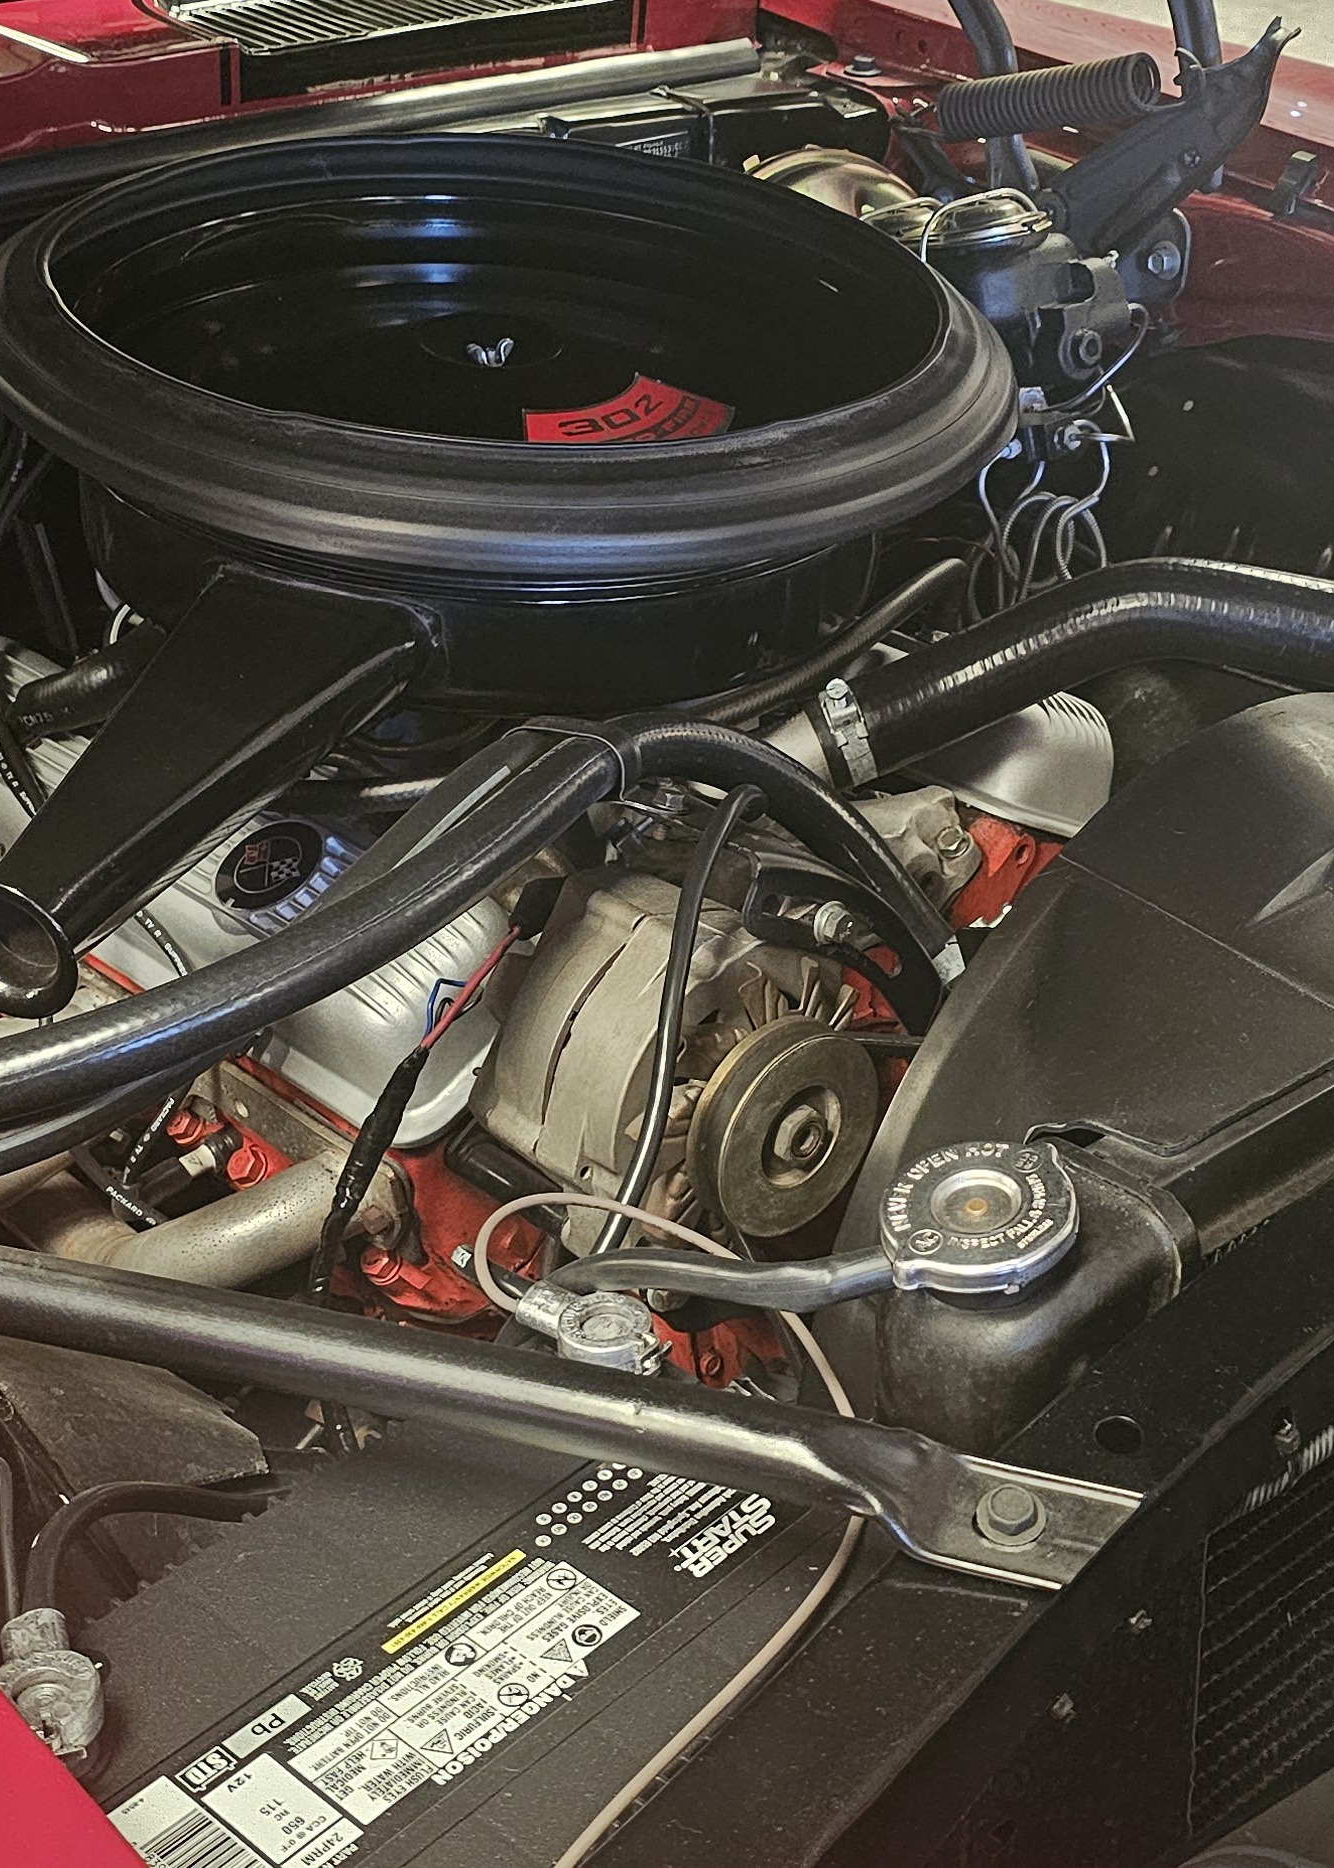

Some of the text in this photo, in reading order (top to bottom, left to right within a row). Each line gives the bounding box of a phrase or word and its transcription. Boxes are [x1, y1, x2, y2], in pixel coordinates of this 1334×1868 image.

[557, 393, 663, 438] 302
[887, 1142, 1010, 1232] NEVER OPEN HOT
[948, 1232, 1005, 1250] INSPECT
[669, 1490, 773, 1570] START
[684, 1508, 778, 1579] SUPER
[447, 1580, 481, 1606] WARRANTY
[554, 1580, 591, 1609] OR INJURY.
[431, 1604, 449, 1618] CALL
[476, 1585, 545, 1637] REACH OF CHILDREN.
[497, 1591, 553, 1633] KEEP OUT OF THE
[525, 1585, 599, 1641] CAN CAUSE BLINDNESS
[540, 1591, 608, 1643] EXPLOSIVE GASES
[591, 1598, 617, 1618] EYES.
[597, 1604, 627, 1627] SHIELD
[395, 1642, 426, 1666] FOLLOW
[399, 1663, 414, 1674] DO
[368, 1662, 400, 1686] PROPER
[385, 1670, 403, 1685] NOT
[386, 1662, 442, 1704] INSTRUCTIONS.
[413, 1668, 449, 1696] READ ALL
[525, 1670, 541, 1683] NO
[333, 1681, 373, 1712] CHARGING
[340, 1681, 389, 1718] DISASSEMBLE
[403, 1683, 459, 1725] SEVERE BURNS.
[415, 1689, 467, 1729] BLINDNESS OR
[434, 1695, 476, 1726] CAN CAUSE
[461, 1701, 485, 1719] ACID
[248, 1711, 286, 1741] Pb
[328, 1714, 343, 1726] OR
[339, 1705, 383, 1738] DO NOT TIP.
[361, 1719, 380, 1734] NOT
[376, 1711, 391, 1723] DO
[427, 1673, 578, 1787] DANGER/POISON
[452, 1708, 495, 1741] SULFURIC
[341, 1731, 365, 1749] OPEN
[181, 1750, 228, 1787] STD
[341, 1750, 366, 1769] HELP
[356, 1750, 416, 1795] WITH WATER.
[224, 1770, 253, 1793] 12V
[324, 1763, 366, 1795] MEDICAL
[333, 1784, 354, 1801] GET
[366, 1757, 425, 1801] IMMEDIATELY
[382, 1764, 434, 1804] FLUSH EYES
[258, 1797, 283, 1816] 115
[280, 1815, 306, 1835] 650
[294, 1830, 306, 1839] @
[303, 1814, 327, 1832] CCA
[299, 1831, 344, 1866] 24PRM
[328, 1842, 359, 1866] PART
